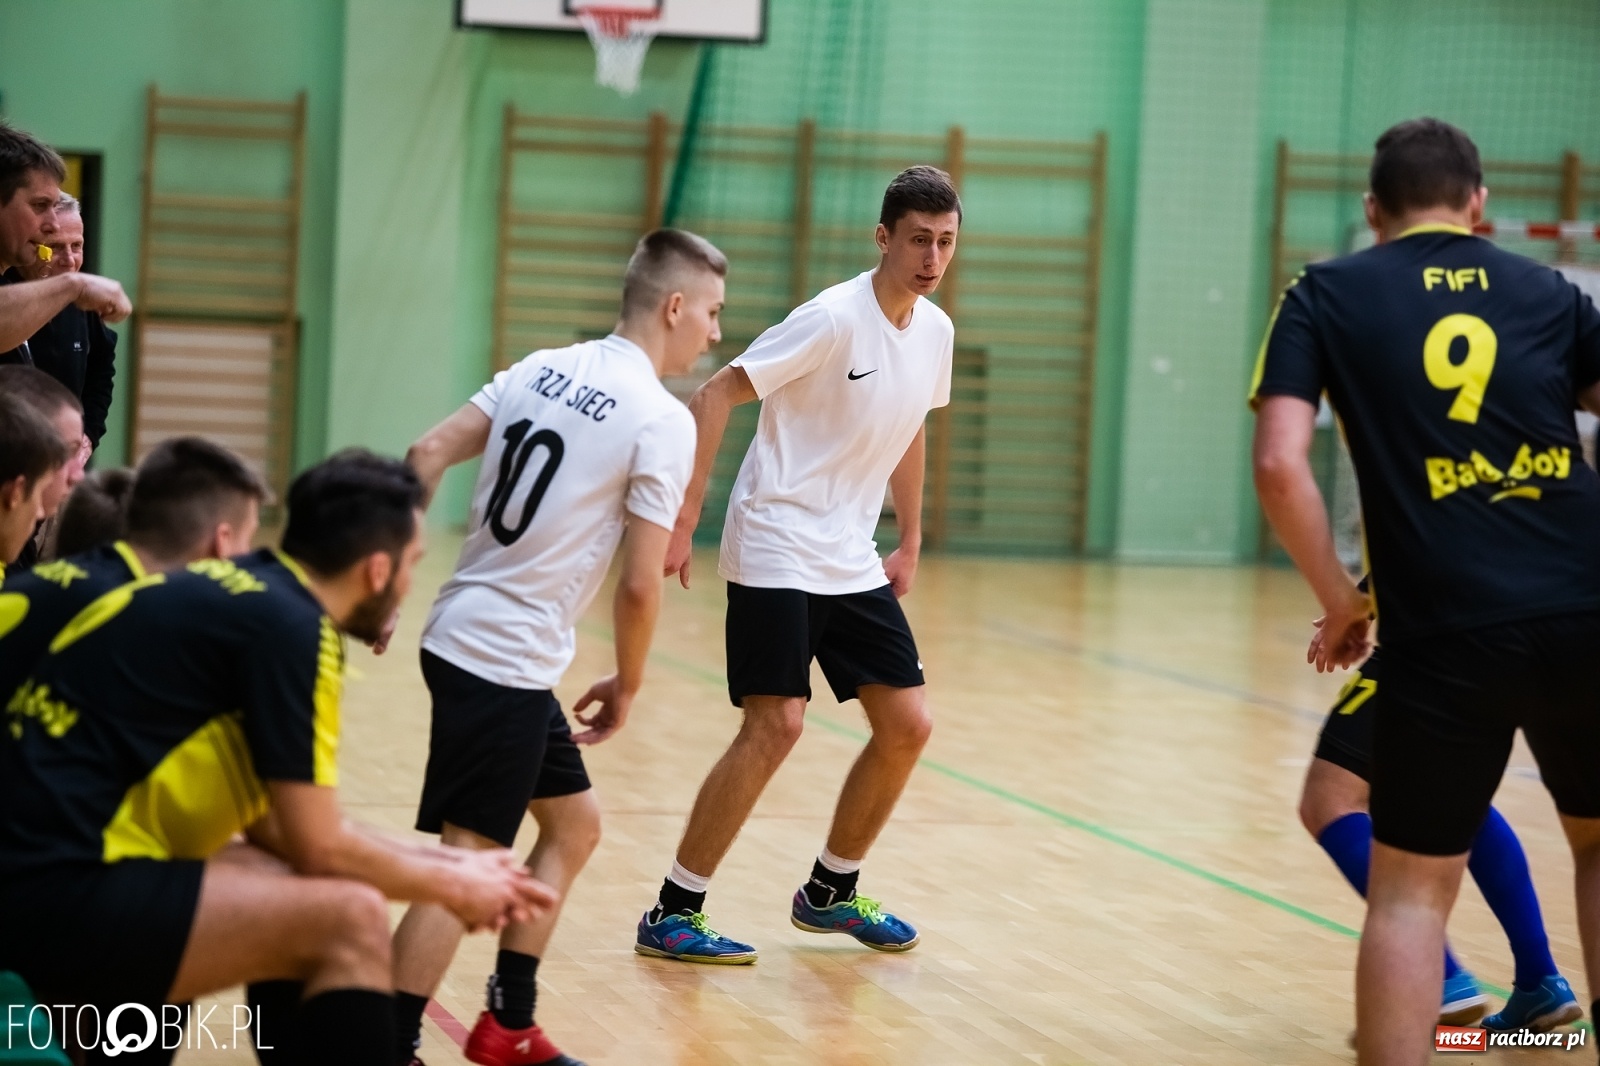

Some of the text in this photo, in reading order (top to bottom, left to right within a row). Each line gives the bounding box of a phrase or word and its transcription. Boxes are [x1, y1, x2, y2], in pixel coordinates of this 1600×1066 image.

[1423, 267, 1489, 291] FIFI
[1423, 313, 1498, 424] 9
[481, 418, 564, 547] 10
